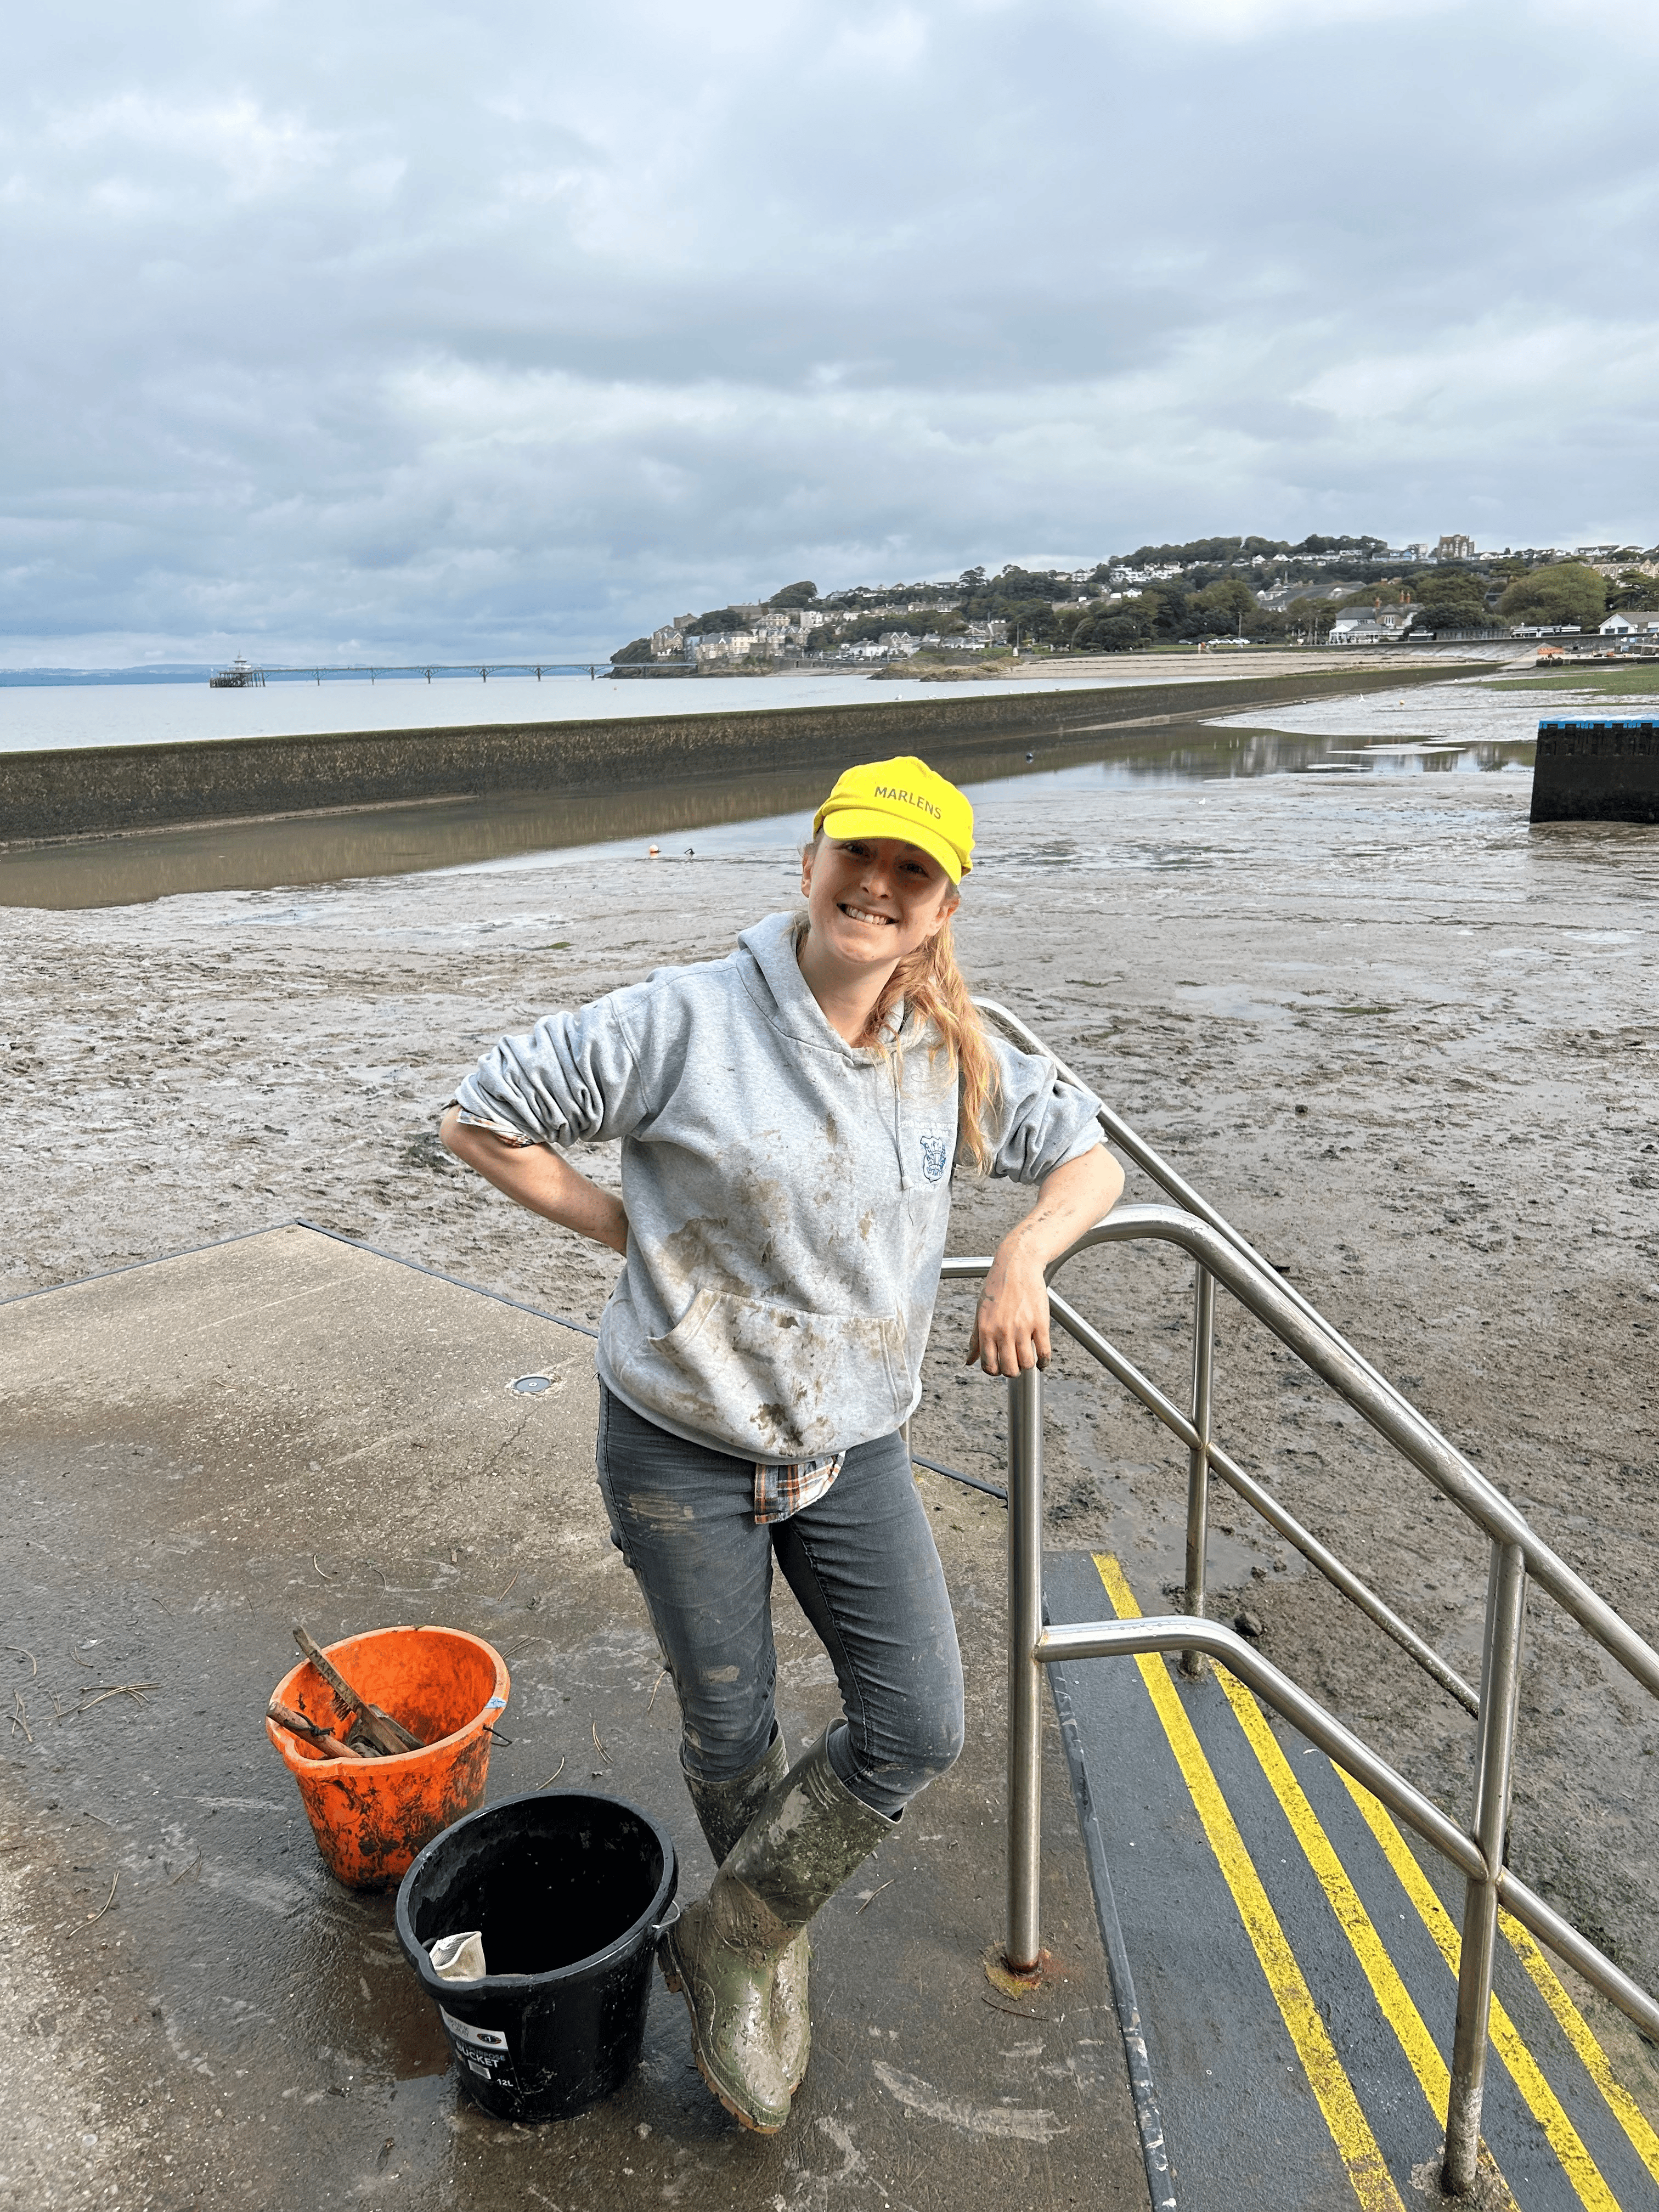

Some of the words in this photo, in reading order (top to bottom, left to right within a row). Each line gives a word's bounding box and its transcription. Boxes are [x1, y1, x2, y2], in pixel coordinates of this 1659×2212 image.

[874, 786, 942, 820] MARLENS
[456, 2041, 499, 2068] BUCKET
[496, 2079, 514, 2087] 12L
